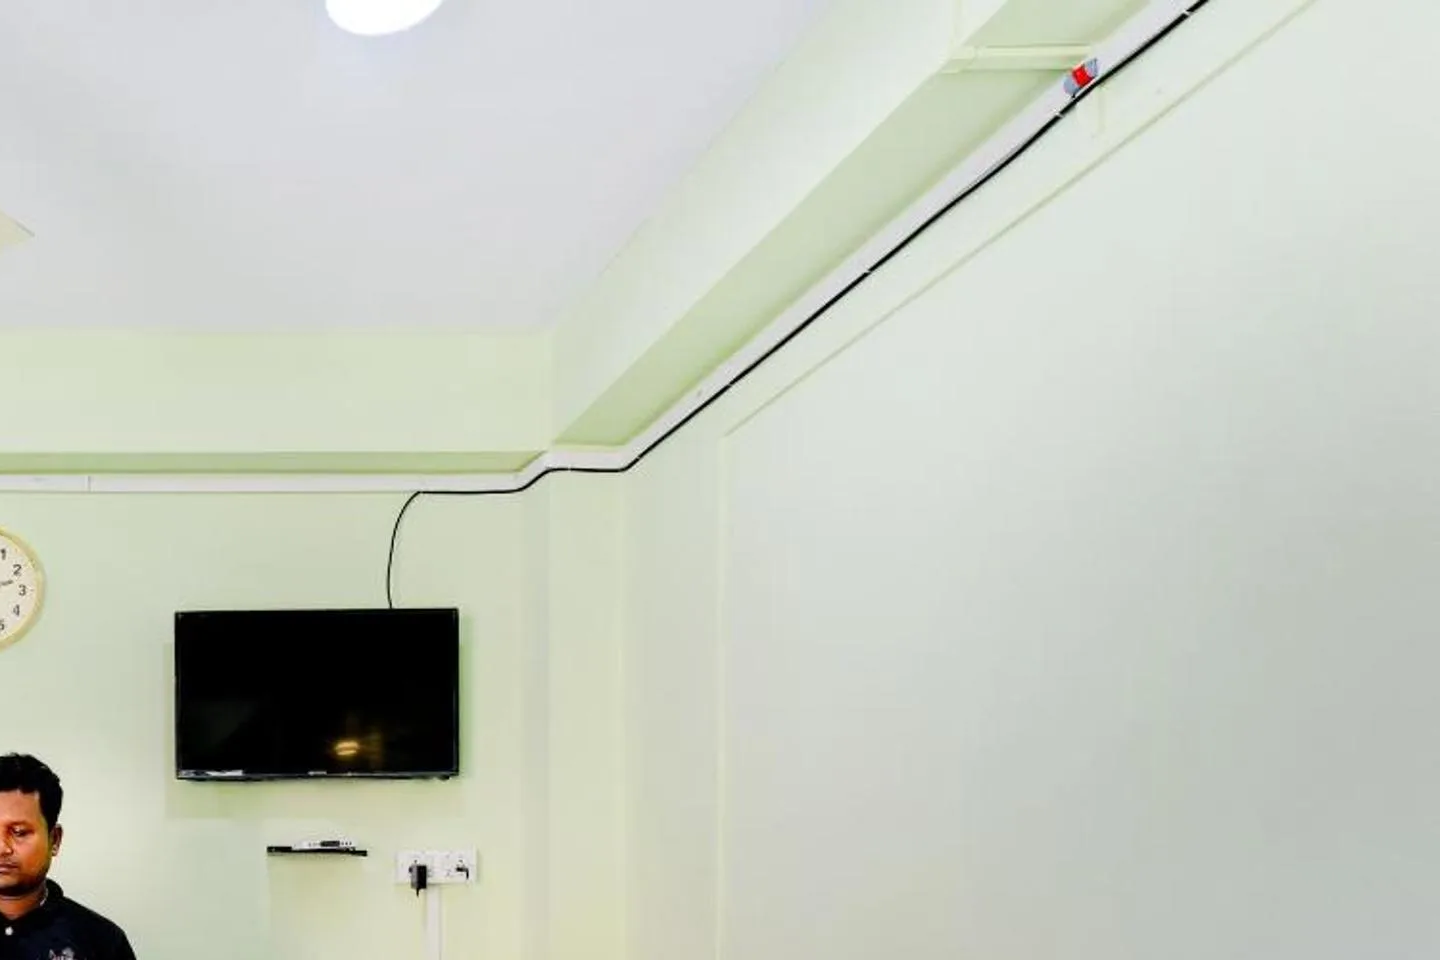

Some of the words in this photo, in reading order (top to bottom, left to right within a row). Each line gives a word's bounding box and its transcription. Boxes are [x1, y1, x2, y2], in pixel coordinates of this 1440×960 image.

[0, 548, 6, 560] 1
[13, 564, 22, 576] 2
[18, 584, 26, 596] 3
[13, 604, 20, 616] 4
